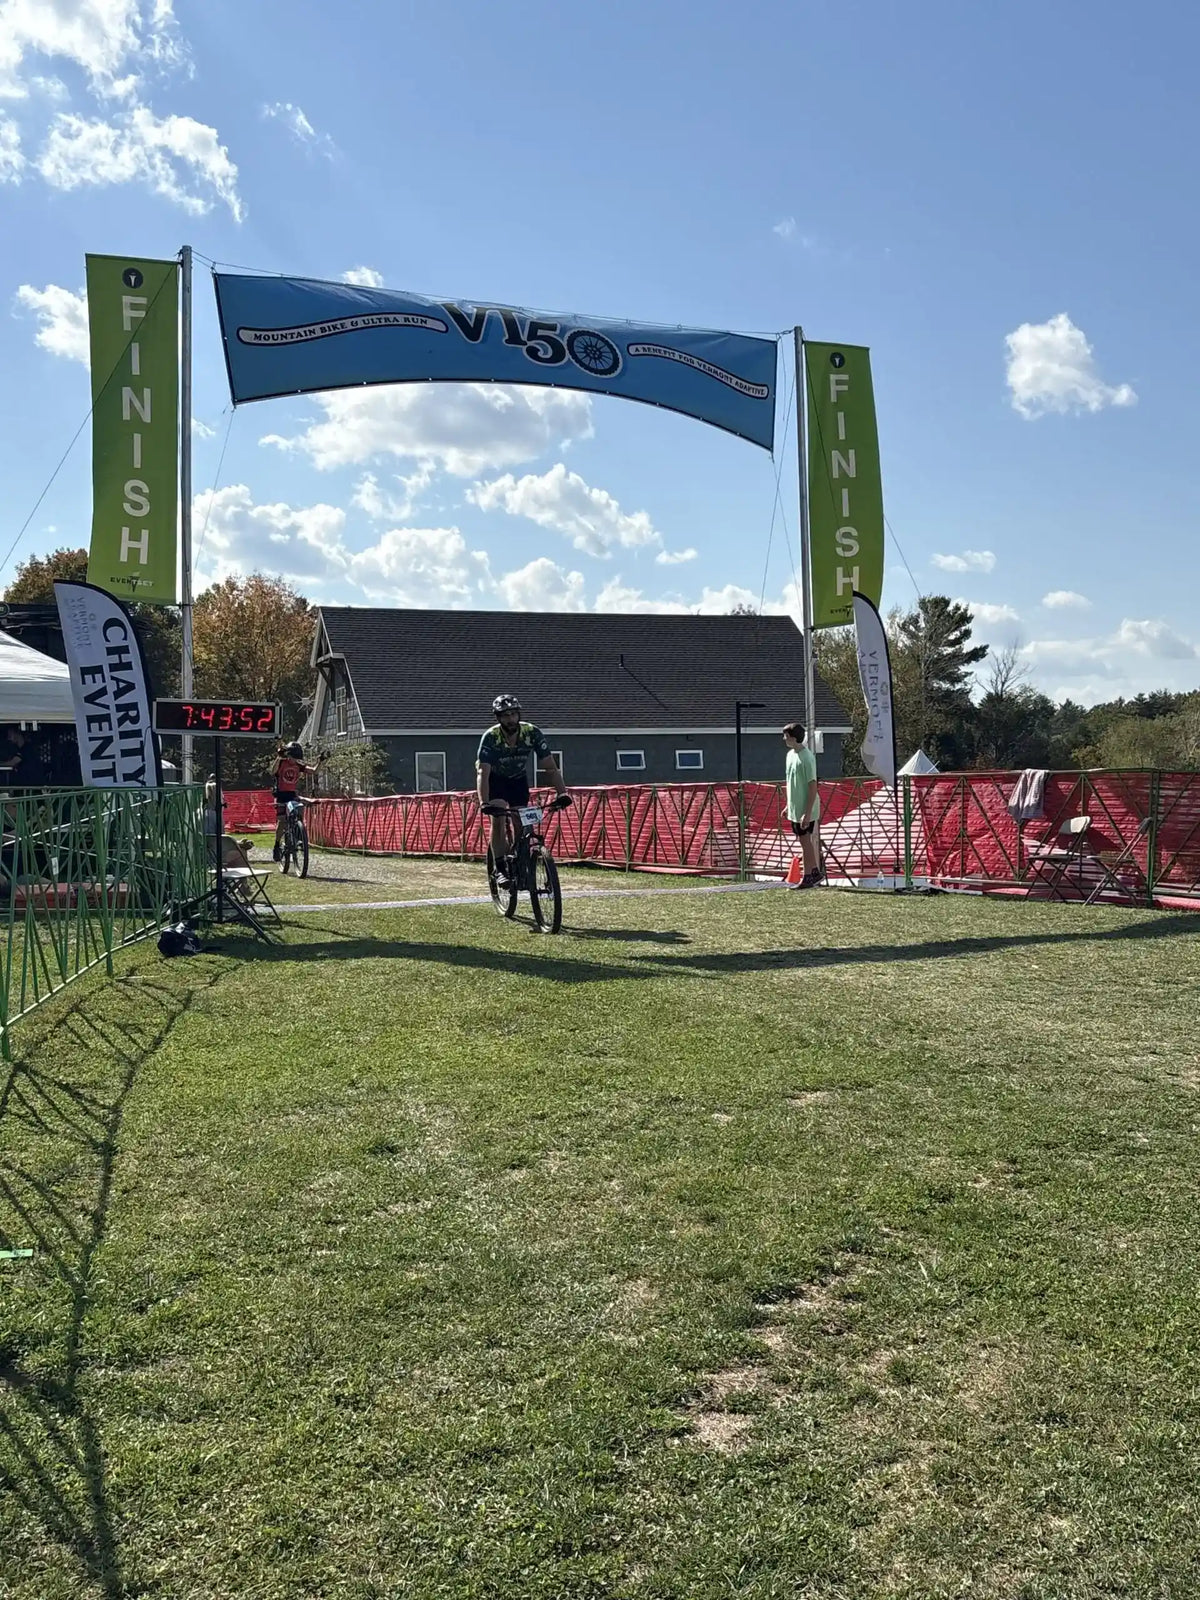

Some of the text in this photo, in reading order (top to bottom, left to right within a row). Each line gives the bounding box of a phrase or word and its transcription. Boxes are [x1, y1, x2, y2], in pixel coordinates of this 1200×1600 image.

[253, 328, 317, 342] MOUNTAIN
[319, 322, 348, 334] BIKE
[361, 316, 400, 326] ULTRA
[403, 316, 428, 326] RUN
[641, 346, 677, 358] BENEFIT
[679, 354, 695, 365] FOR
[696, 360, 733, 384] VERMONT
[734, 380, 766, 396] ADAPTIVE
[120, 295, 151, 565] FINISH
[829, 373, 861, 597] FINISH
[80, 664, 118, 783] EVENT
[102, 617, 147, 787] CHARITY
[182, 705, 273, 731] 7:43:52
